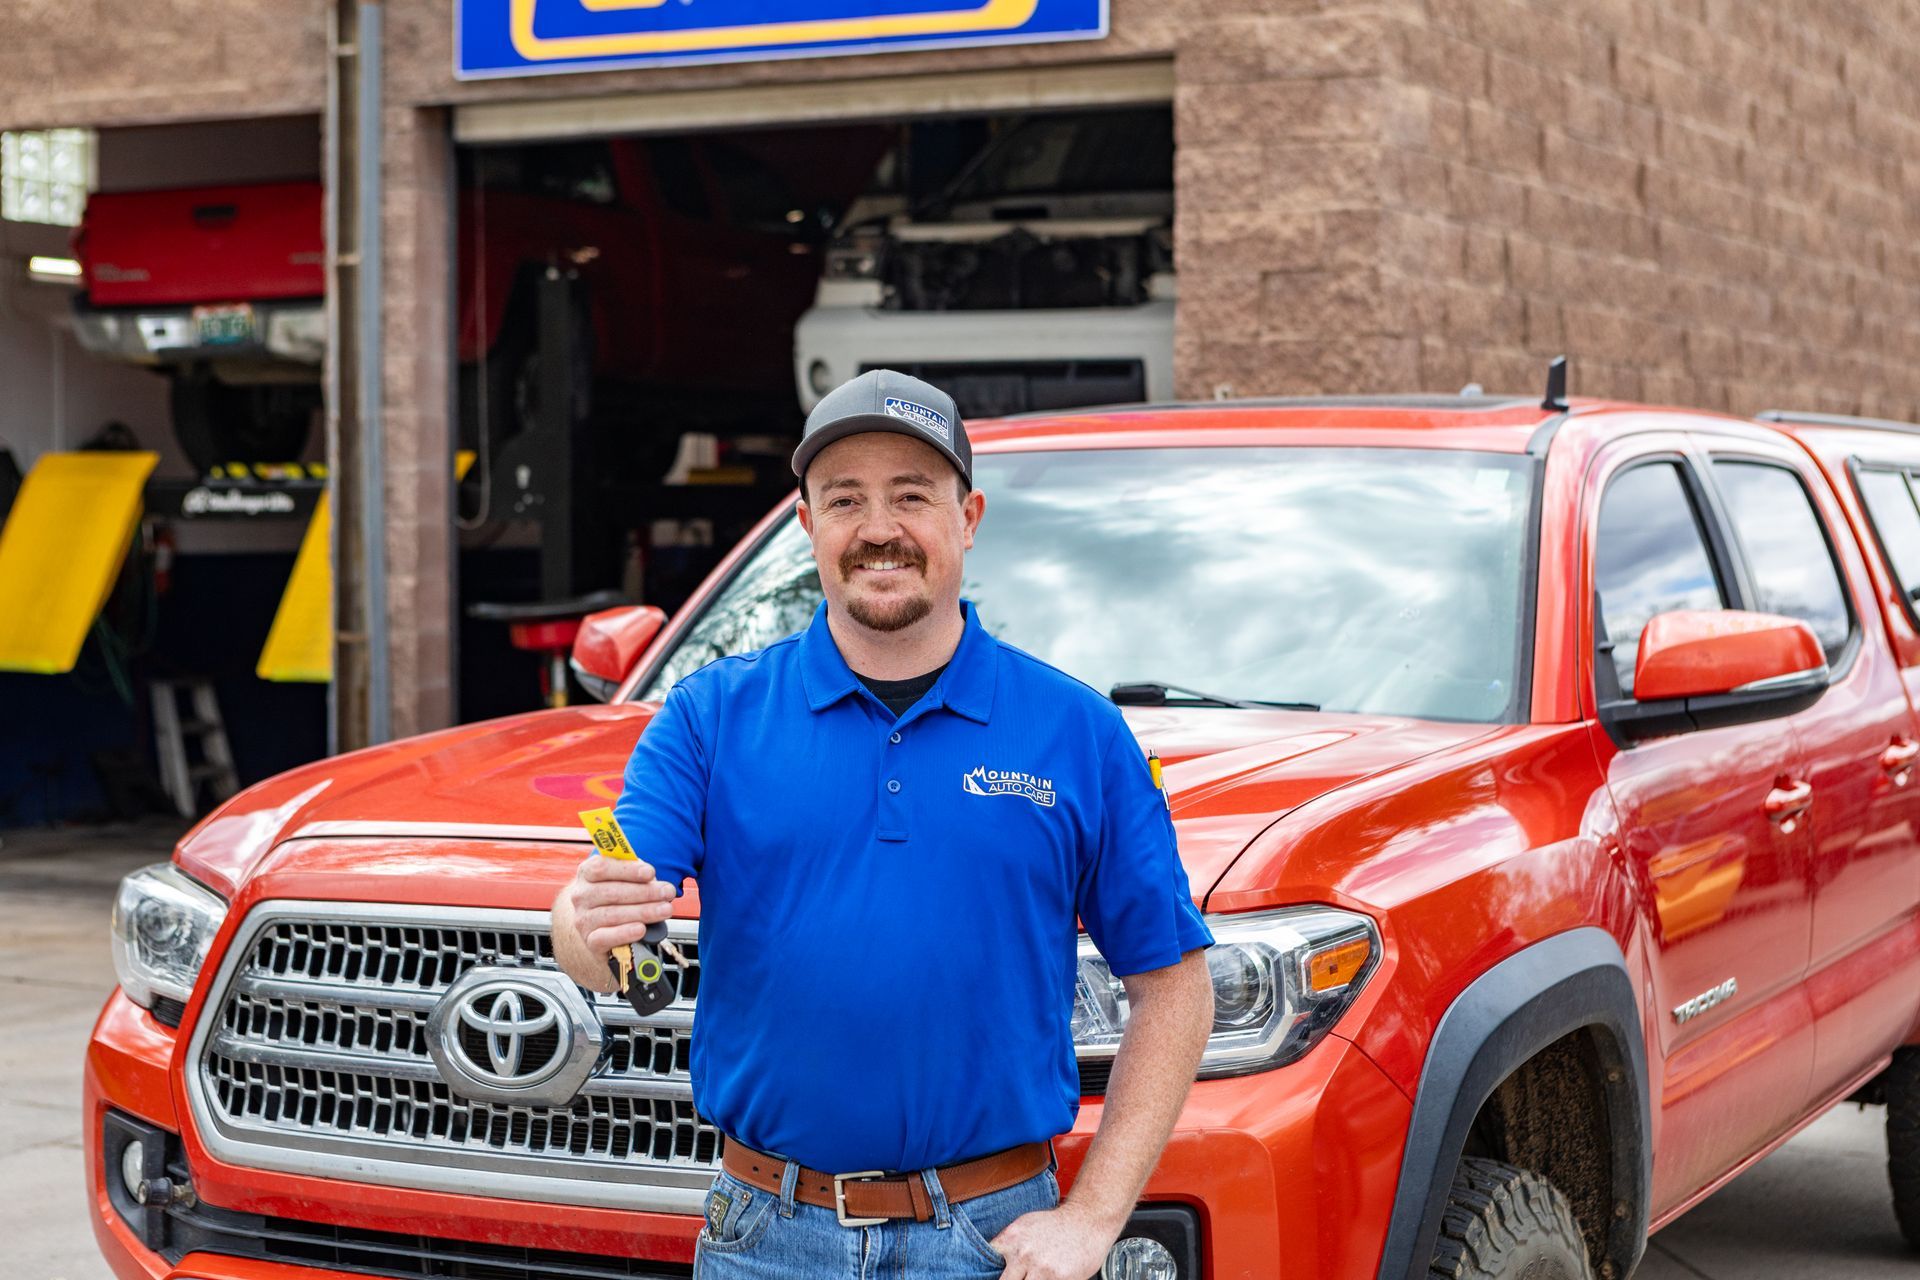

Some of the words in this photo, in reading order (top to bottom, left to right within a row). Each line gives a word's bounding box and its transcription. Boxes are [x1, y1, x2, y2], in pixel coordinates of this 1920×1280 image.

[890, 400, 947, 428] MOUNTAIN
[903, 411, 927, 425] AUTO
[971, 765, 1052, 790] MOUNTAIN
[988, 782, 1022, 793] AUTO
[1024, 786, 1051, 803] CARE
[1673, 976, 1737, 1024] TACOMA
